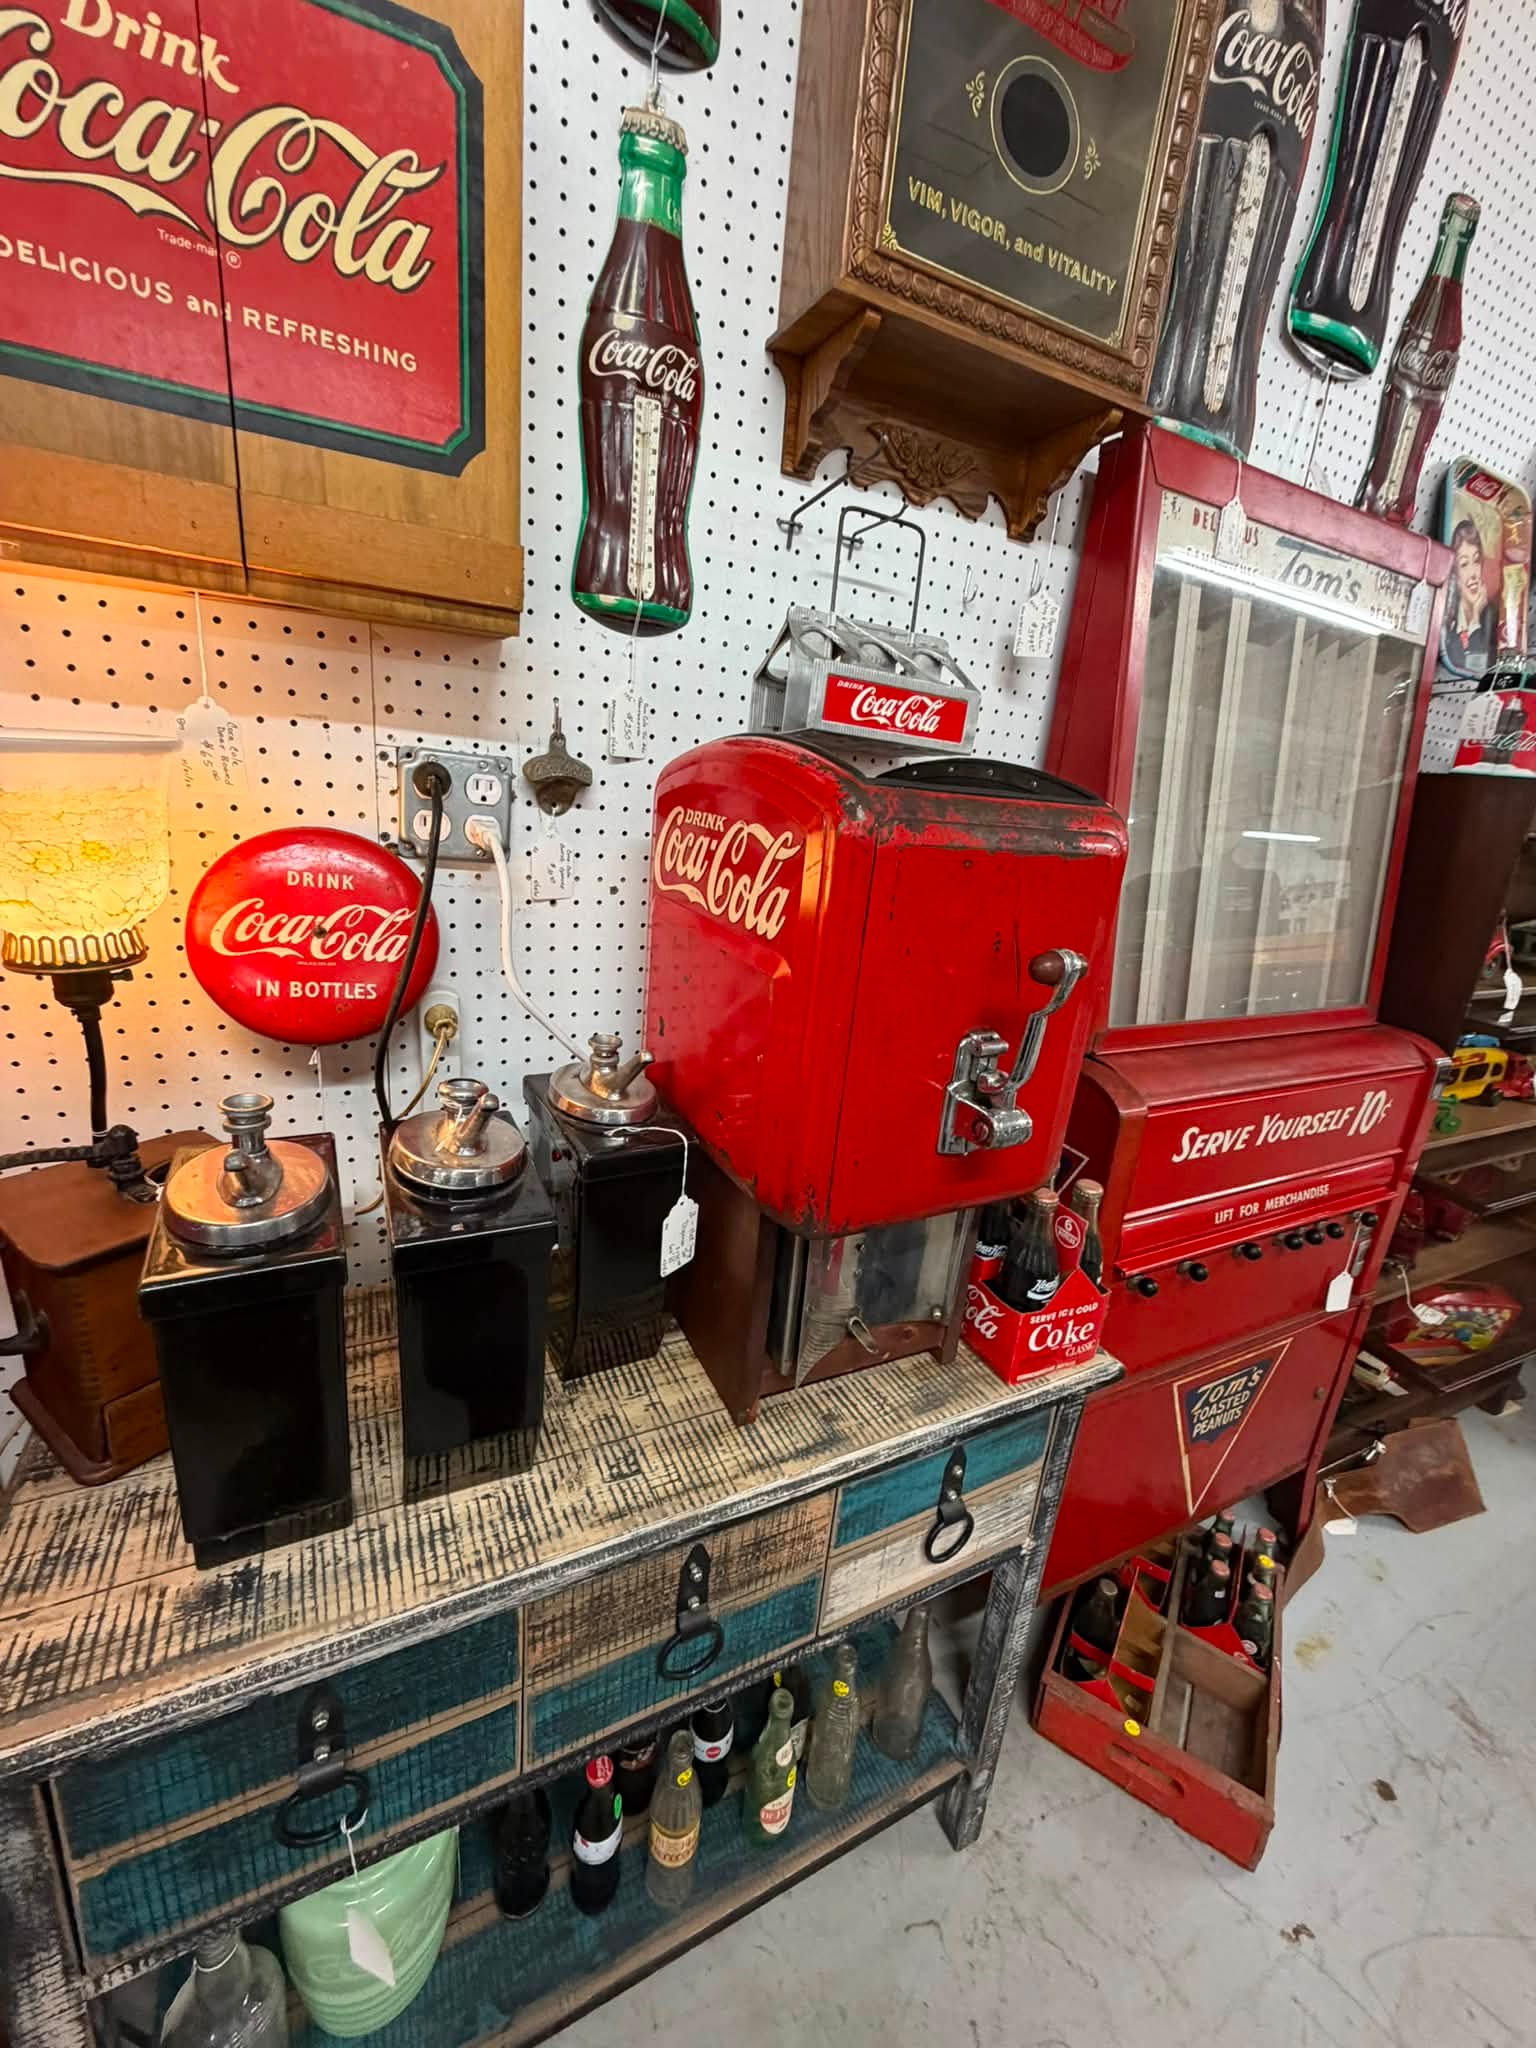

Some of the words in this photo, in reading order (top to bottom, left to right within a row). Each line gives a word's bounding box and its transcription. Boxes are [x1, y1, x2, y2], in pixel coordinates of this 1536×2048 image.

[60, 0, 240, 93] Drink
[1209, 10, 1319, 139] Coca-Cola
[908, 176, 948, 219] VIM,
[951, 198, 1011, 251] VIGOR,
[1014, 235, 1044, 264] and
[1048, 249, 1117, 296] VITALITY
[242, 306, 416, 373] REFRESHING
[589, 329, 699, 402] Coca-Cola
[1275, 536, 1362, 603] Tom's
[837, 679, 864, 691] DRINK
[850, 687, 946, 734] Coca-Cola
[684, 808, 727, 833] DRINK
[287, 870, 354, 891] DRINK
[655, 806, 803, 940] Coca-Cola
[210, 897, 417, 964] Coca-Cola
[256, 980, 283, 998] IN
[290, 980, 377, 1000] BOTTLES
[1172, 1124, 1255, 1163] SERVE
[1255, 1106, 1355, 1147] YOURSELF
[1065, 1219, 1073, 1232] 6
[1215, 1211, 1234, 1225] LIFT
[1240, 1202, 1259, 1217] FOR
[1264, 1184, 1331, 1212] MERCHANDISE
[1076, 1302, 1099, 1315] COLD
[1028, 1319, 1095, 1352] Coke
[1192, 1405, 1244, 1438] PEANUTS
[1193, 1390, 1250, 1423] TOASTED
